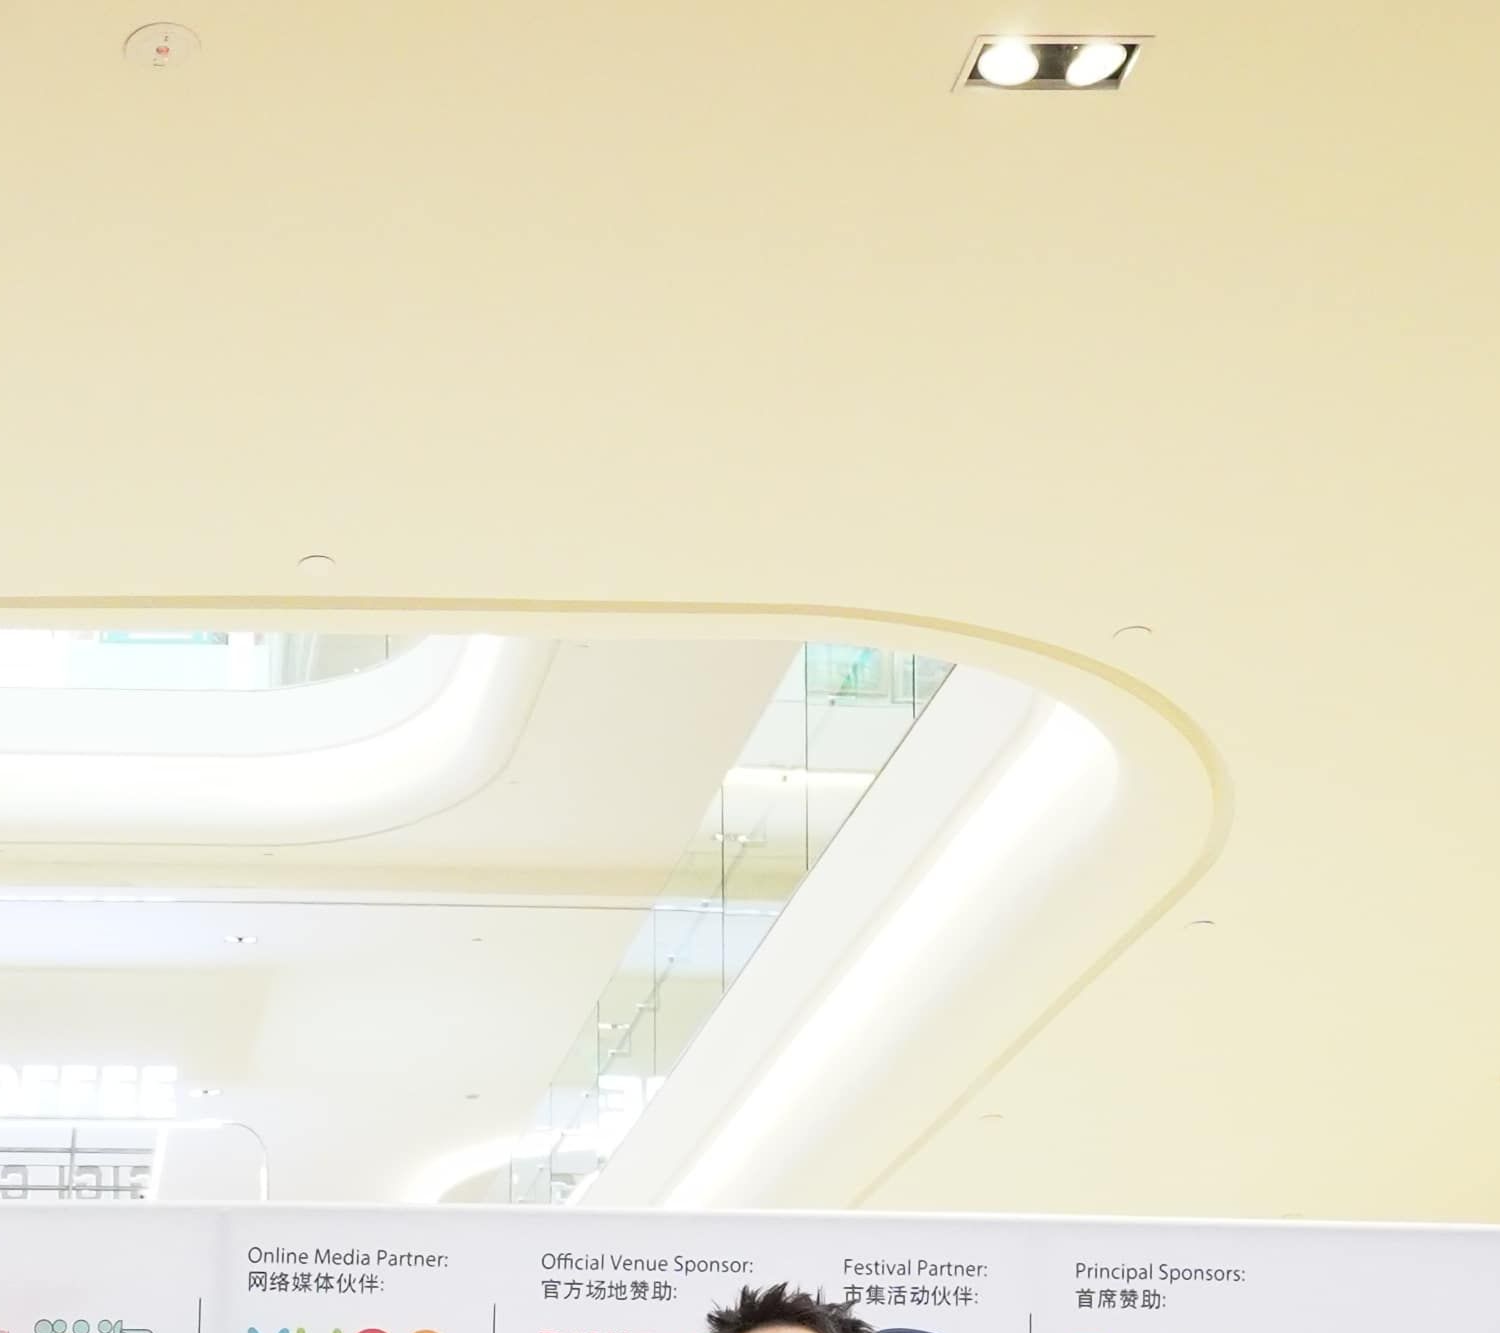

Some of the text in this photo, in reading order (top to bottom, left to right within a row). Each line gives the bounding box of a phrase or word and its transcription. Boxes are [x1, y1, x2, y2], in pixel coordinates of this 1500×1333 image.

[248, 1247, 448, 1267] Online Media Partner:
[542, 1253, 752, 1276] Official Venue Sponsor:
[844, 1259, 987, 1277] Festival Partner:
[1076, 1263, 1245, 1284] Principal Sponsors:
[249, 1271, 384, 1294] 网络媒体伙伴:
[542, 1279, 676, 1301] 官方场地赞助:
[844, 1284, 979, 1308] 市集活动伙伴:
[1076, 1288, 1165, 1309] 首席赞助:
